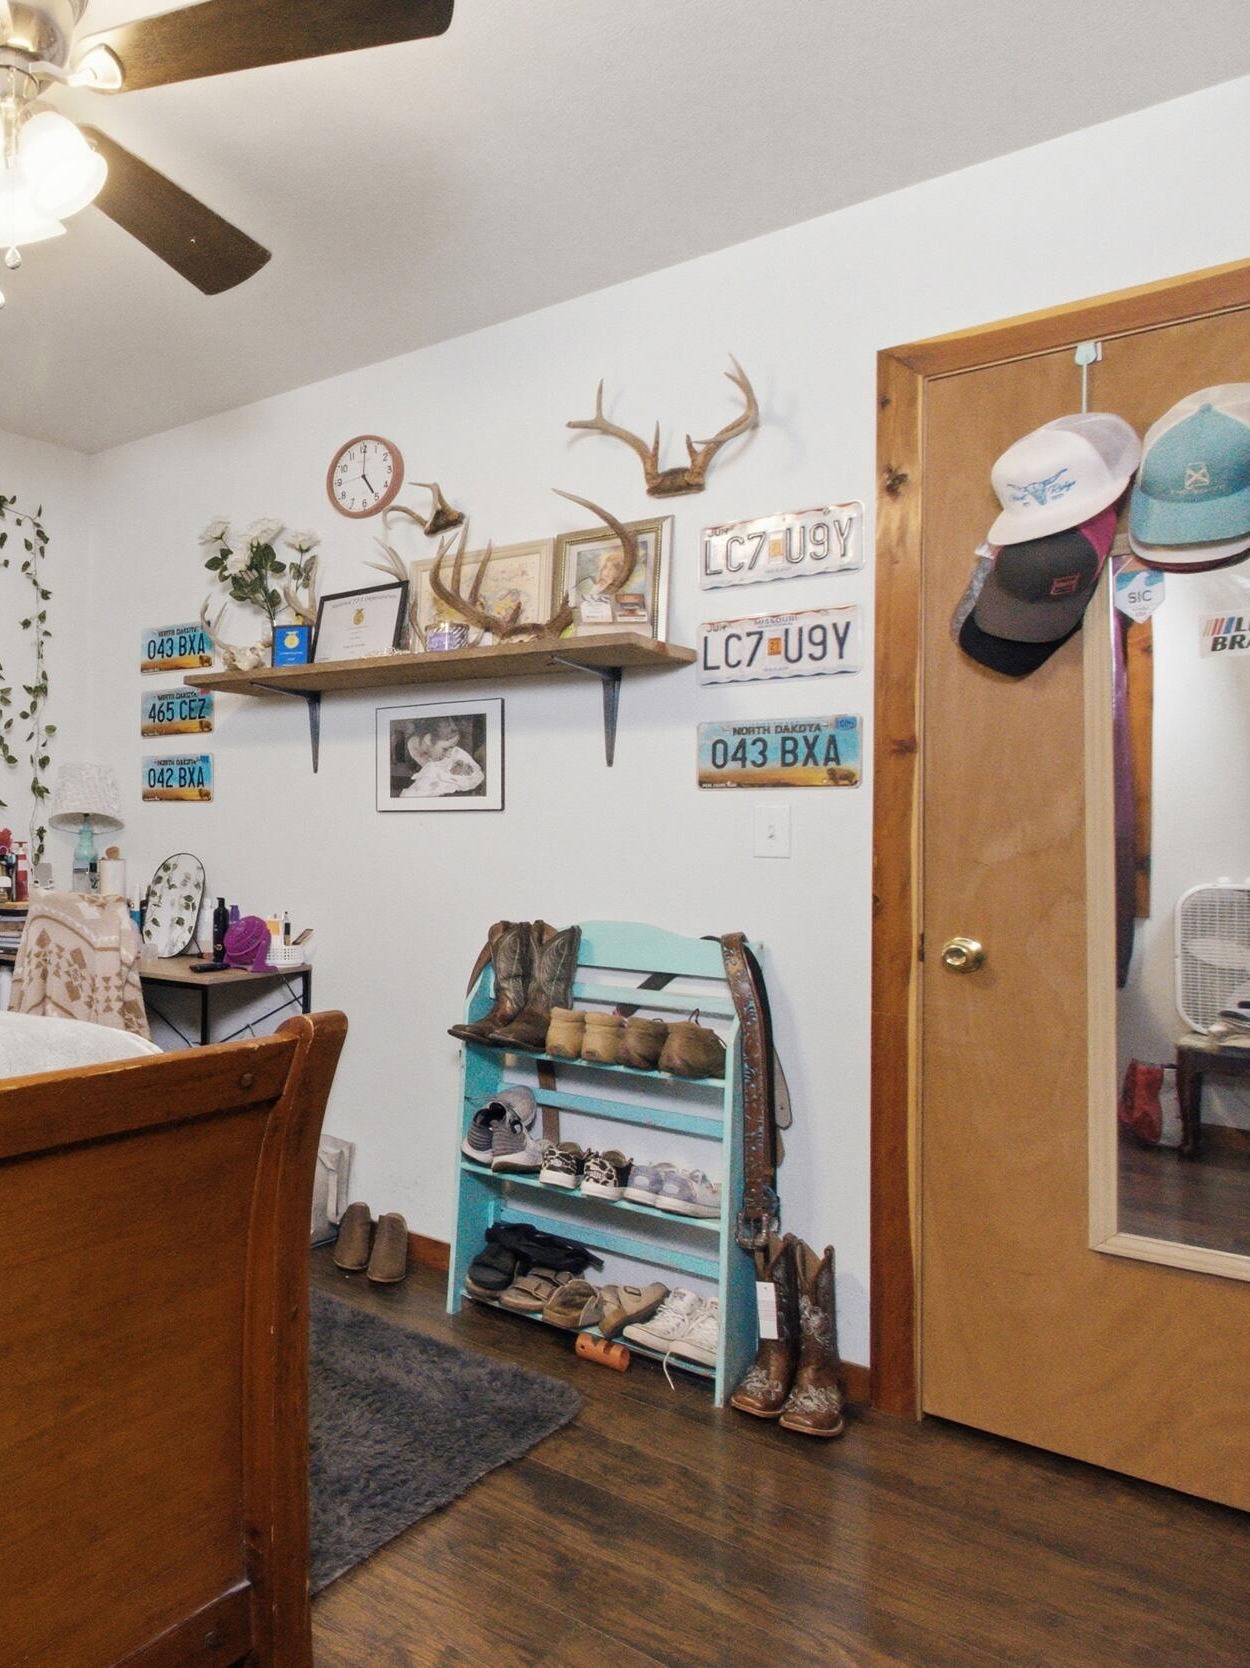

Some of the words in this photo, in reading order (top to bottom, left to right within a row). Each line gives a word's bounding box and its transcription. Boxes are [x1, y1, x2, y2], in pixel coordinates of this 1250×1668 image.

[704, 531, 766, 576] LC7
[785, 517, 853, 564] U9Y
[147, 637, 174, 660] 043
[178, 633, 206, 657] BXA
[703, 630, 764, 671] LC7
[784, 621, 851, 663] U9Y
[148, 701, 175, 723] 465
[179, 698, 206, 721] CEZ
[733, 726, 771, 736] NORTH
[775, 723, 821, 734] DAKOTA
[711, 737, 768, 769] 043
[780, 734, 841, 768] BXA
[148, 768, 174, 789] 042
[178, 766, 205, 789] BXA
